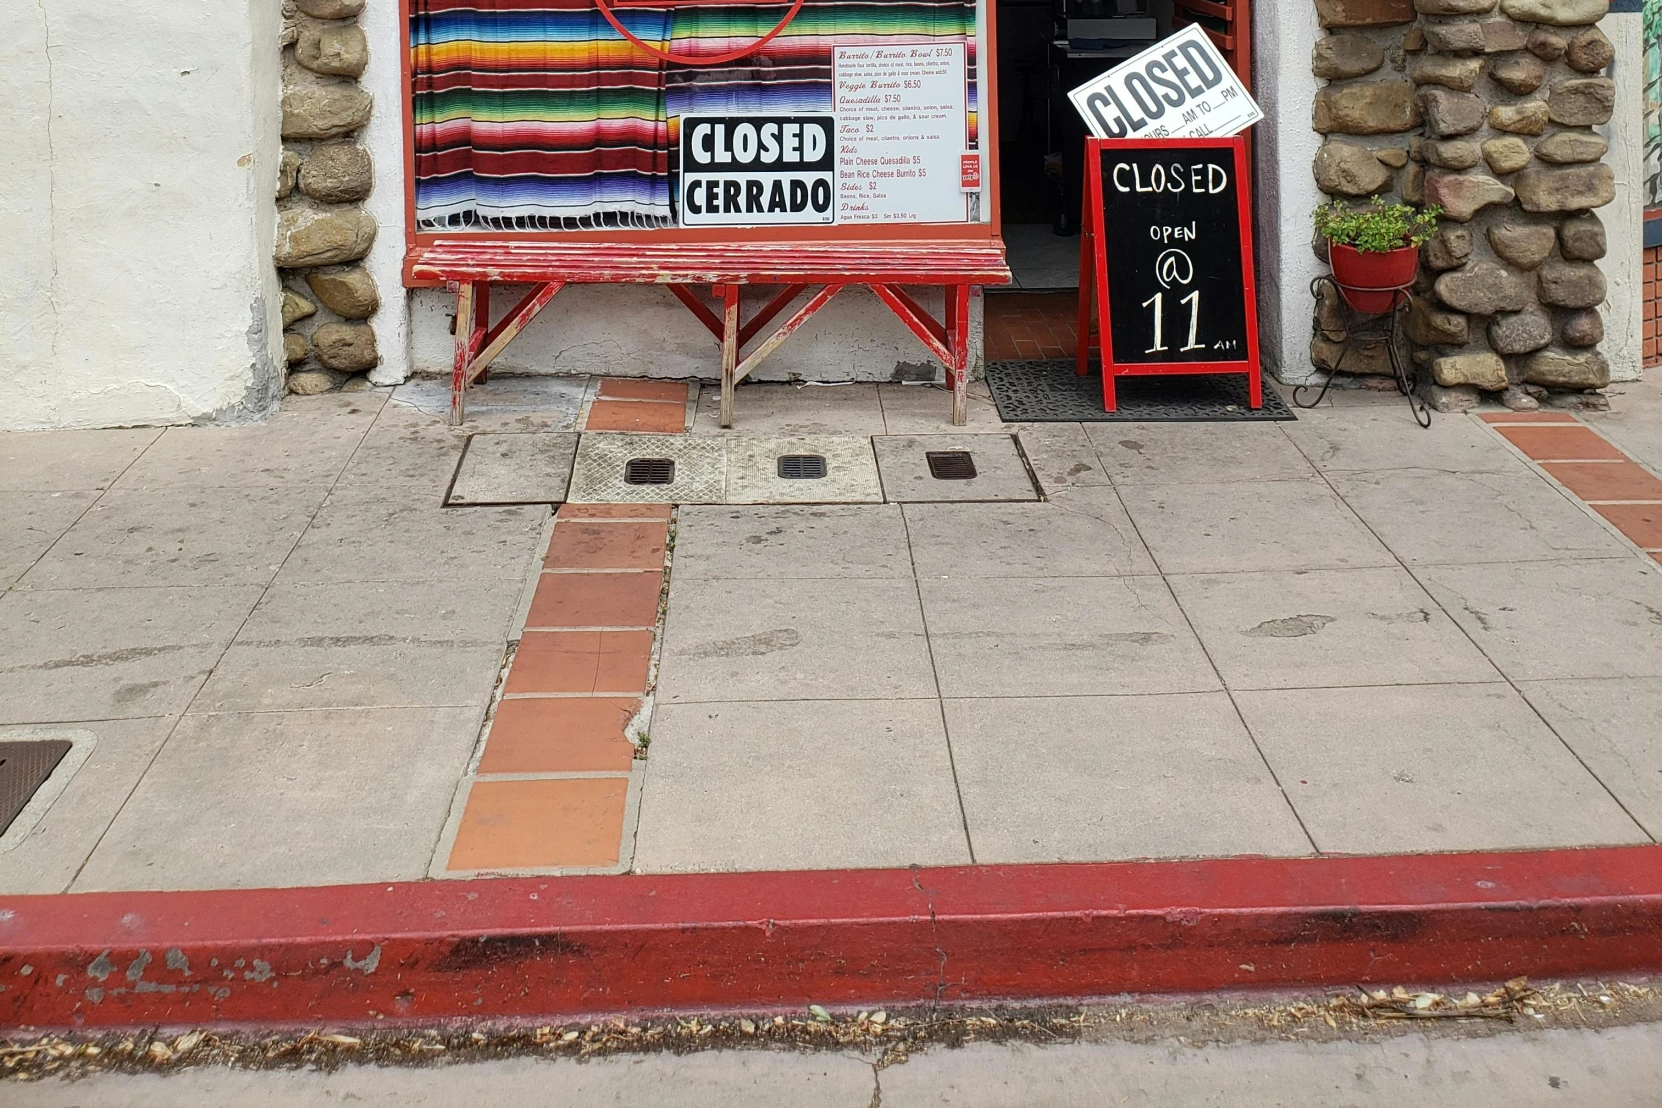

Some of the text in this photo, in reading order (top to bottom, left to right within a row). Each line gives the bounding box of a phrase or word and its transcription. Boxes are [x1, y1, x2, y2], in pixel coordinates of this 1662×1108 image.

[838, 48, 953, 60] Burrito/Burrito Bowl $7.50
[839, 80, 922, 92] Veggie Burrito $6.50
[1086, 39, 1223, 138] CLOSED
[840, 94, 902, 104] Quesadilla $7.50
[1141, 86, 1239, 138] OURS AM TO PM
[840, 124, 874, 133] Taco $2
[1189, 124, 1214, 138] CALL
[691, 122, 827, 164] CLOSED
[840, 145, 858, 154] Kids
[840, 156, 921, 166] Plain Cheese Quesadilla $5
[840, 168, 927, 178] Bean Rice Cheese Burrito $5
[1113, 162, 1227, 194] CLOSED
[840, 182, 877, 191] Sides $2
[686, 178, 831, 215] CERRADO
[841, 202, 869, 211] Drinks
[1150, 221, 1196, 243] OPEN
[1156, 248, 1194, 289] @
[1142, 290, 1237, 354] 11 AM
